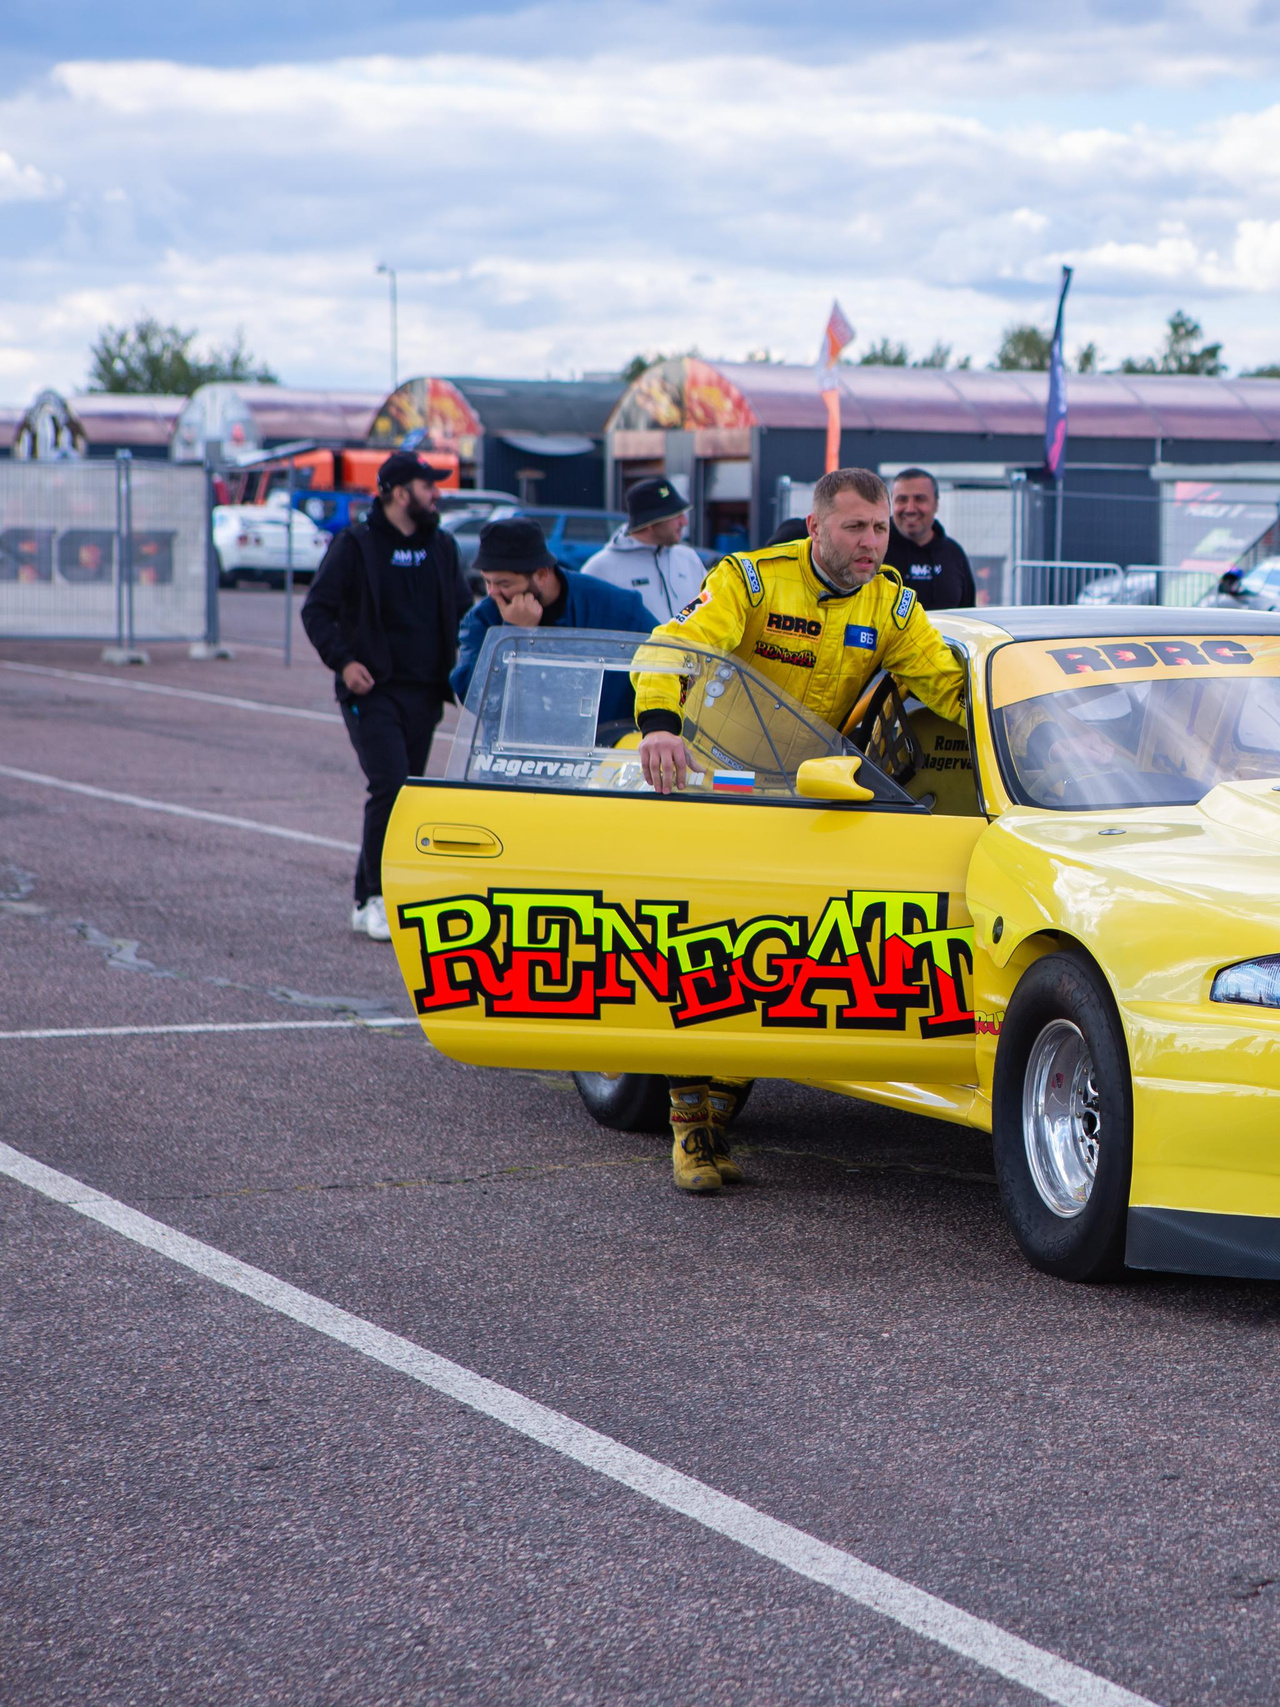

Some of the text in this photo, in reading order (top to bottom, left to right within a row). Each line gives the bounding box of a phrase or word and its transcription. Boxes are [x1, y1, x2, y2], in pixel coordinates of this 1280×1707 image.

[767, 613, 822, 637] RDRC
[1046, 640, 1254, 675] RDRC
[398, 888, 974, 1039] RENEGATT
